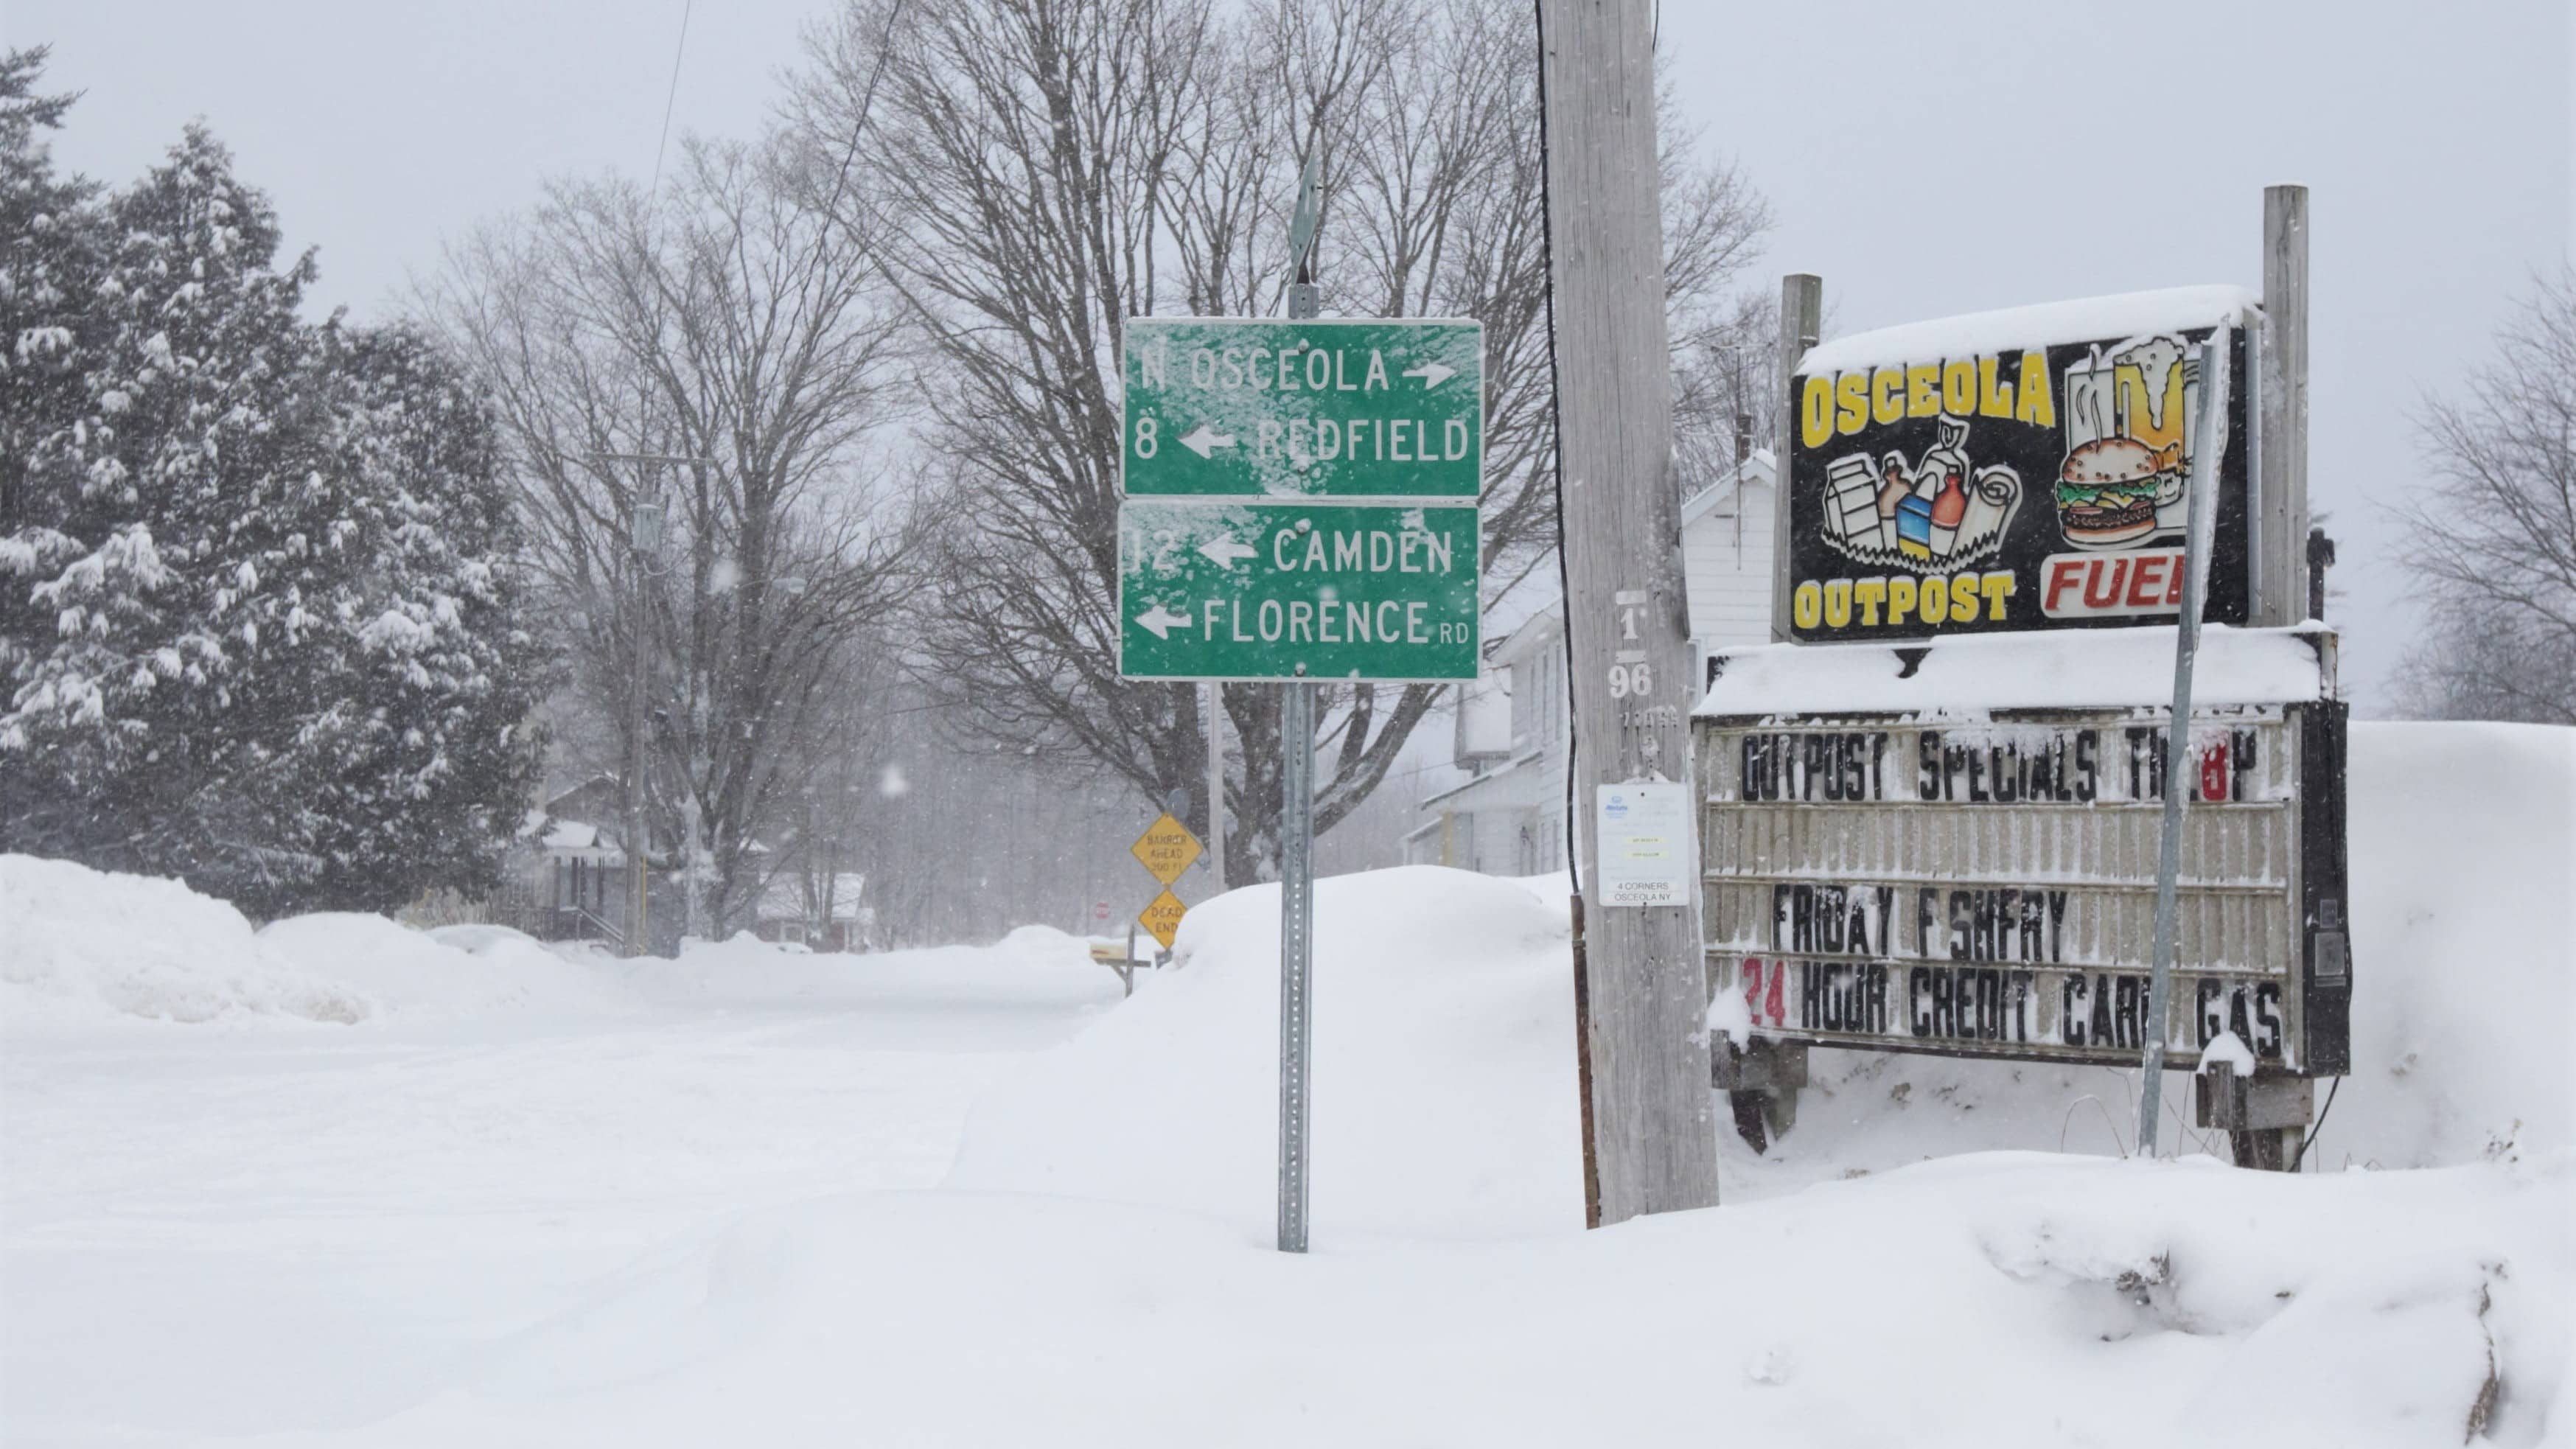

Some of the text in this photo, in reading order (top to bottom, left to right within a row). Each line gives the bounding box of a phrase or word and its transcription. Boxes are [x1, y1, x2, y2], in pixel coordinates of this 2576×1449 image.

[1141, 347, 1389, 391] N OSCEOLA
[1801, 349, 2056, 449] OSCEOLA
[1134, 416, 1468, 461] 8 REDFIELD
[1274, 528, 1452, 573] CAMDEN
[1204, 598, 1469, 644] FLORENCE RD
[1793, 571, 2016, 629] OUTPOST
[1620, 607, 1639, 640] 1
[1608, 663, 1652, 698] 96
[1742, 731, 1888, 801] OUTPOST
[1919, 729, 2096, 802] SPECIALS
[1614, 893, 1656, 901] OSCEOLA
[1624, 881, 1669, 890] CORNERS
[1151, 907, 1182, 918] DEAD
[1155, 921, 1179, 933] END
[1773, 884, 1893, 956] FRIDAY
[1742, 958, 1786, 1027] 24
[1801, 961, 1887, 1033] HOUR
[1909, 966, 2034, 1041] CREDIT
[2196, 977, 2280, 1058] GAS
